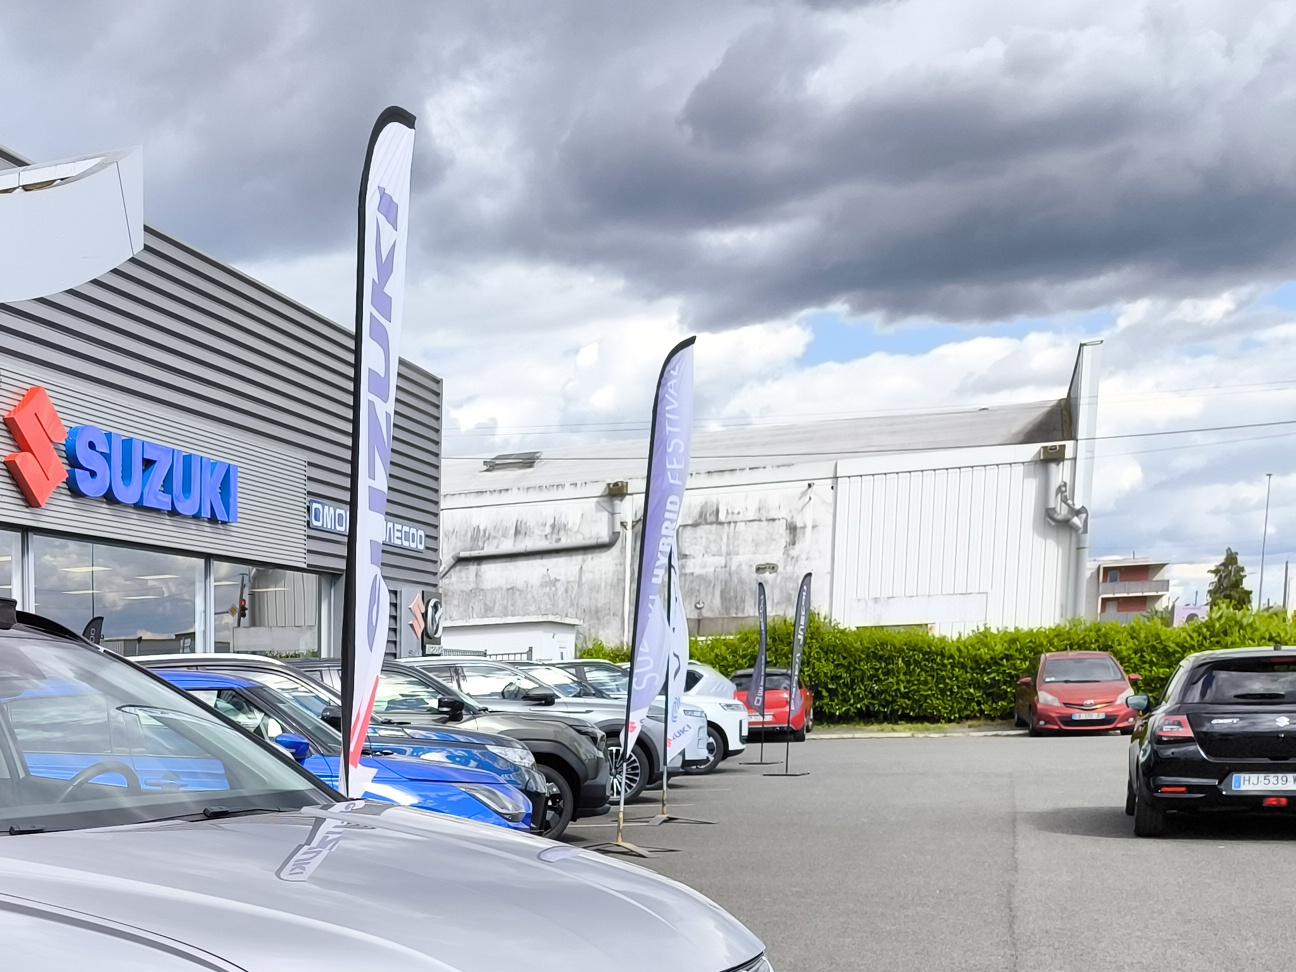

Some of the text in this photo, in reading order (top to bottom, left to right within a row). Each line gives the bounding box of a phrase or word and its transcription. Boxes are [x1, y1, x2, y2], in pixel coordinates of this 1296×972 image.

[664, 363, 686, 487] FESTIVAL
[66, 425, 238, 523] SUZUKI
[311, 502, 426, 550] OMO AECOO
[651, 494, 681, 584] HYBRID
